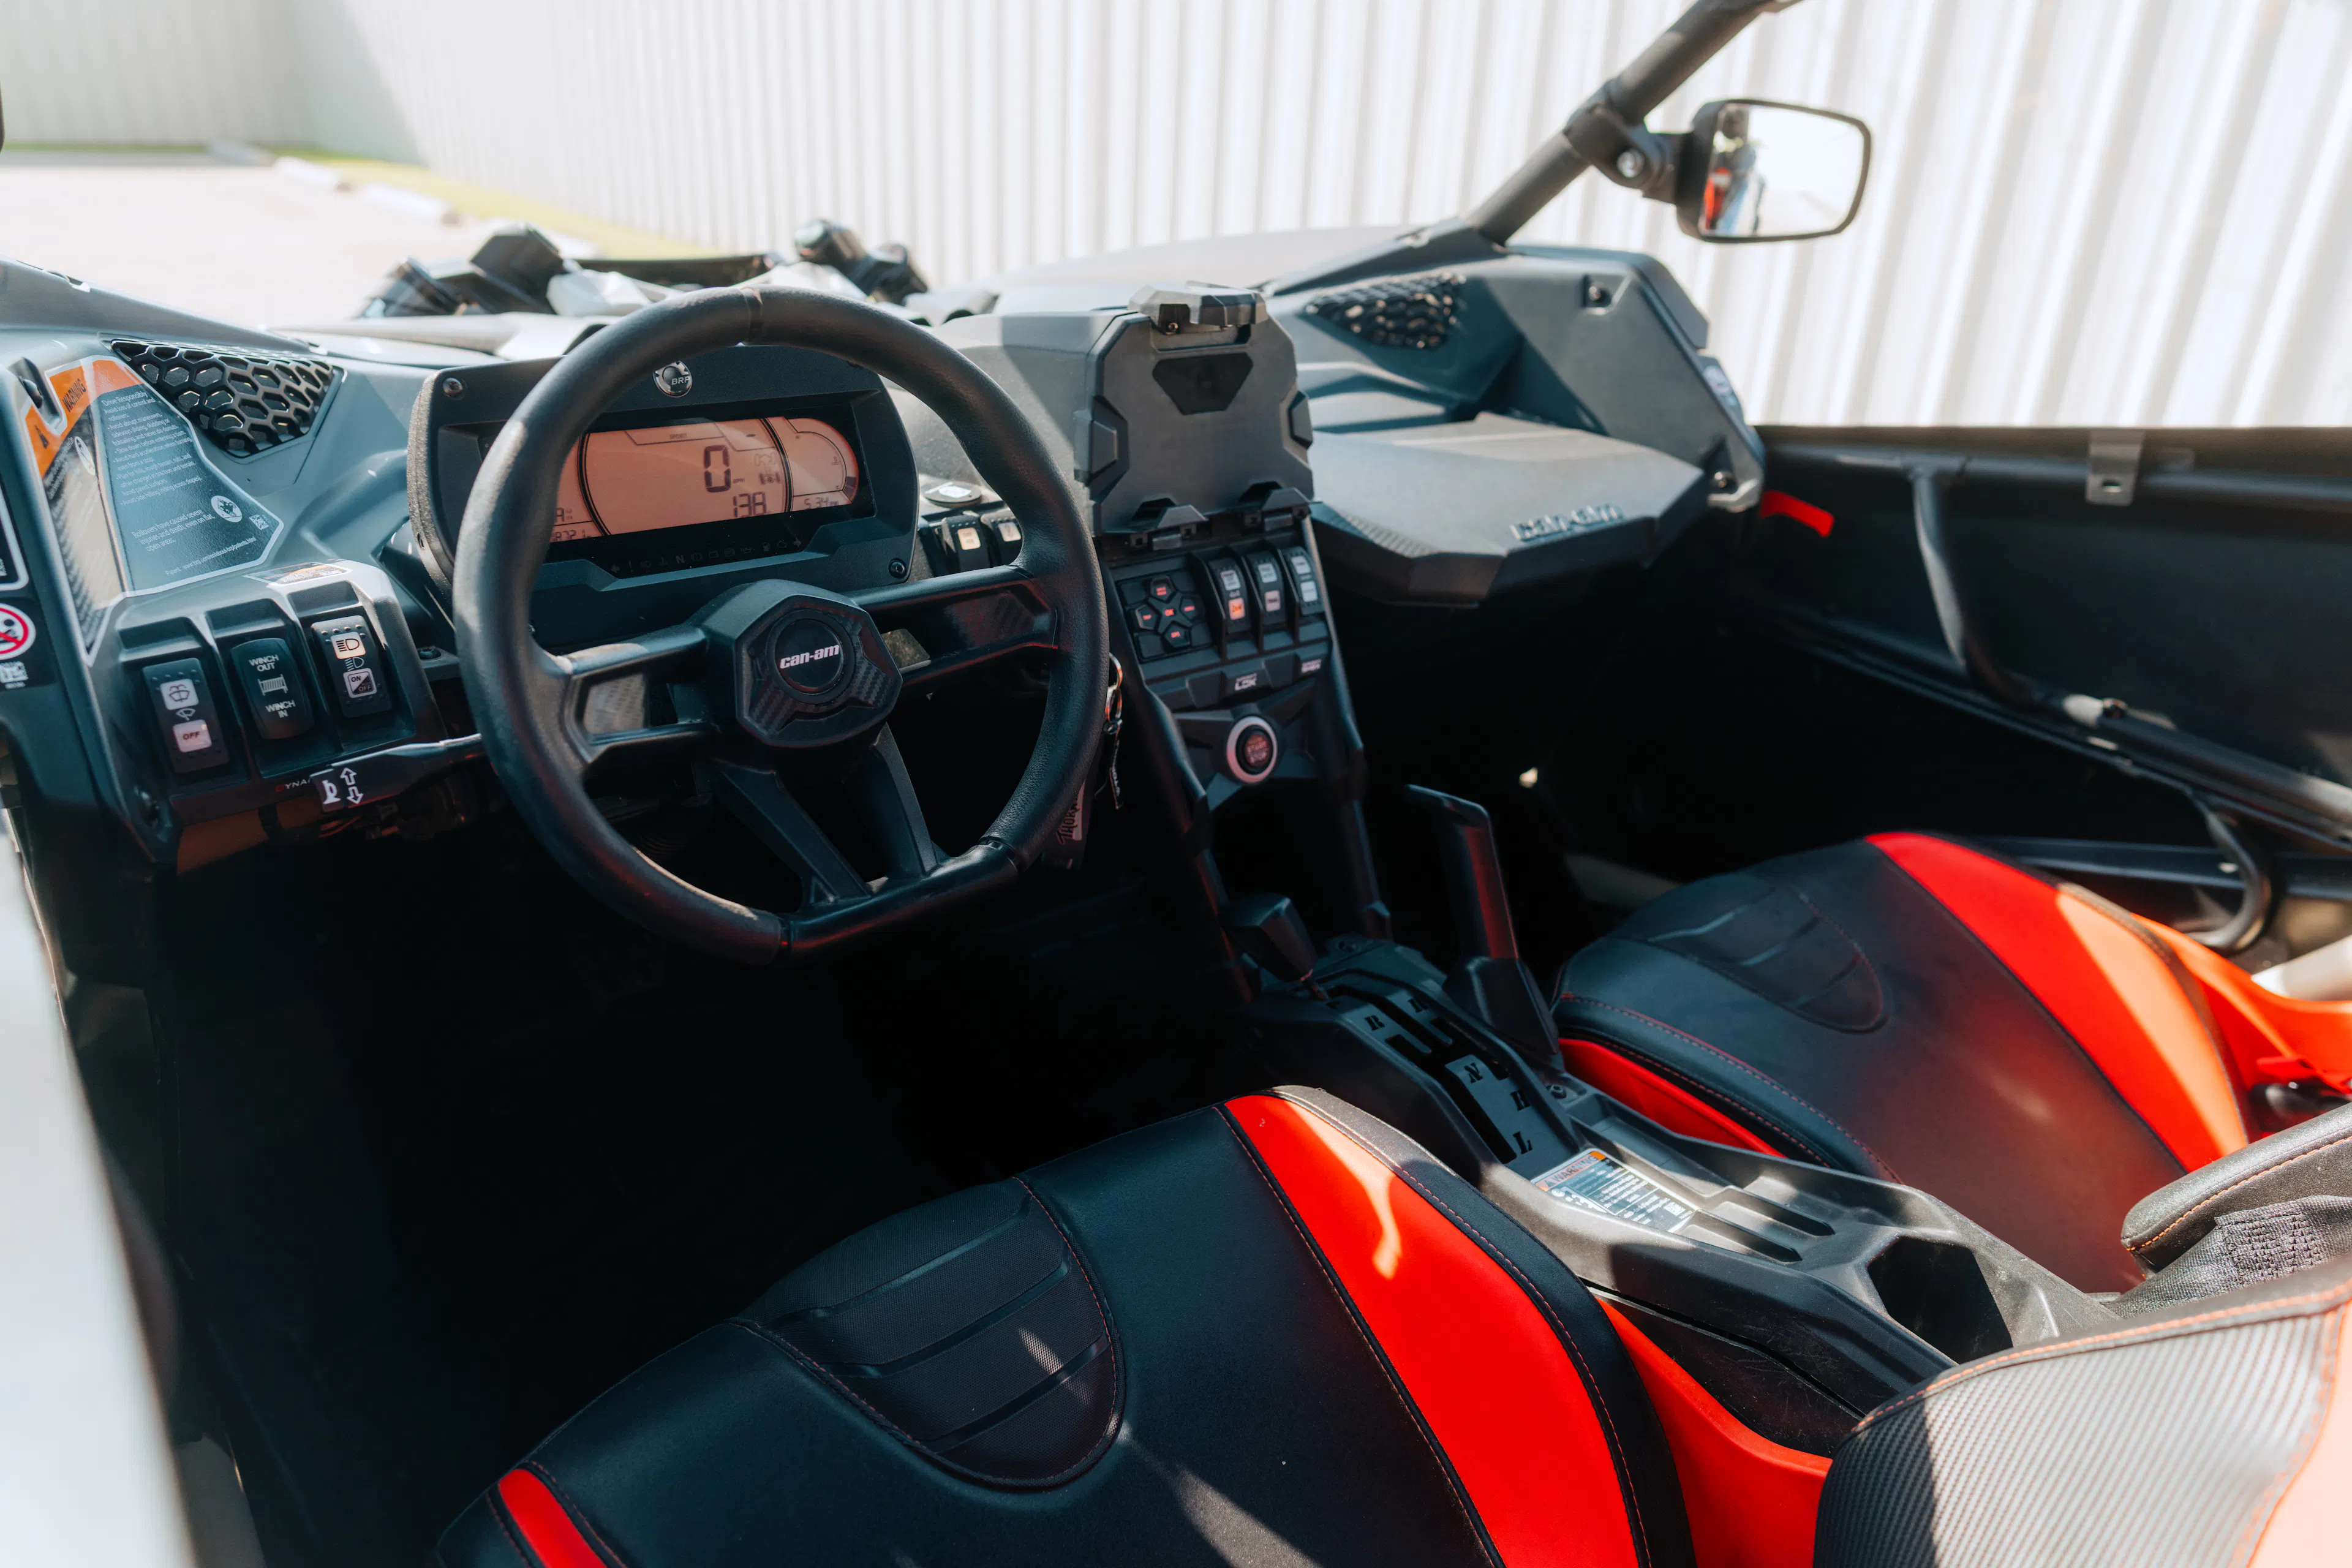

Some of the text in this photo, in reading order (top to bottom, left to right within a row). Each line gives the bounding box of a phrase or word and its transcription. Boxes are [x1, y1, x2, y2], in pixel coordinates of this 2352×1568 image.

[671, 376, 690, 385] BRP
[62, 377, 86, 413] WARNING
[116, 391, 148, 403] Responsibly
[104, 405, 118, 414] Avoid
[111, 429, 133, 438] sideways
[147, 421, 165, 430] skidding
[123, 418, 138, 428] abrupt
[116, 446, 128, 454] Slow
[127, 442, 141, 451] down
[141, 439, 157, 448] before
[156, 434, 173, 443] entering
[129, 452, 140, 461] hard
[139, 445, 164, 456] acceleration
[145, 464, 159, 472] rough
[704, 445, 731, 492] 0
[133, 475, 153, 484] changes
[135, 484, 150, 494] paved
[733, 492, 767, 518] 138
[131, 509, 204, 538] Rollovers have caused severe
[139, 534, 160, 545] injuries
[170, 524, 187, 535] death,
[145, 537, 176, 552] open areas.
[249, 654, 280, 666] WINCH
[779, 644, 840, 669] can-am
[256, 662, 276, 672] OUT
[265, 700, 296, 713] WINCH
[277, 709, 288, 718] IN
[183, 731, 201, 741] OFF
[276, 778, 311, 792] DYNA
[1364, 1015, 1385, 1031] R
[1464, 1062, 1483, 1083] N
[1513, 1131, 1533, 1155] L
[1551, 1154, 1600, 1184] WARNING
